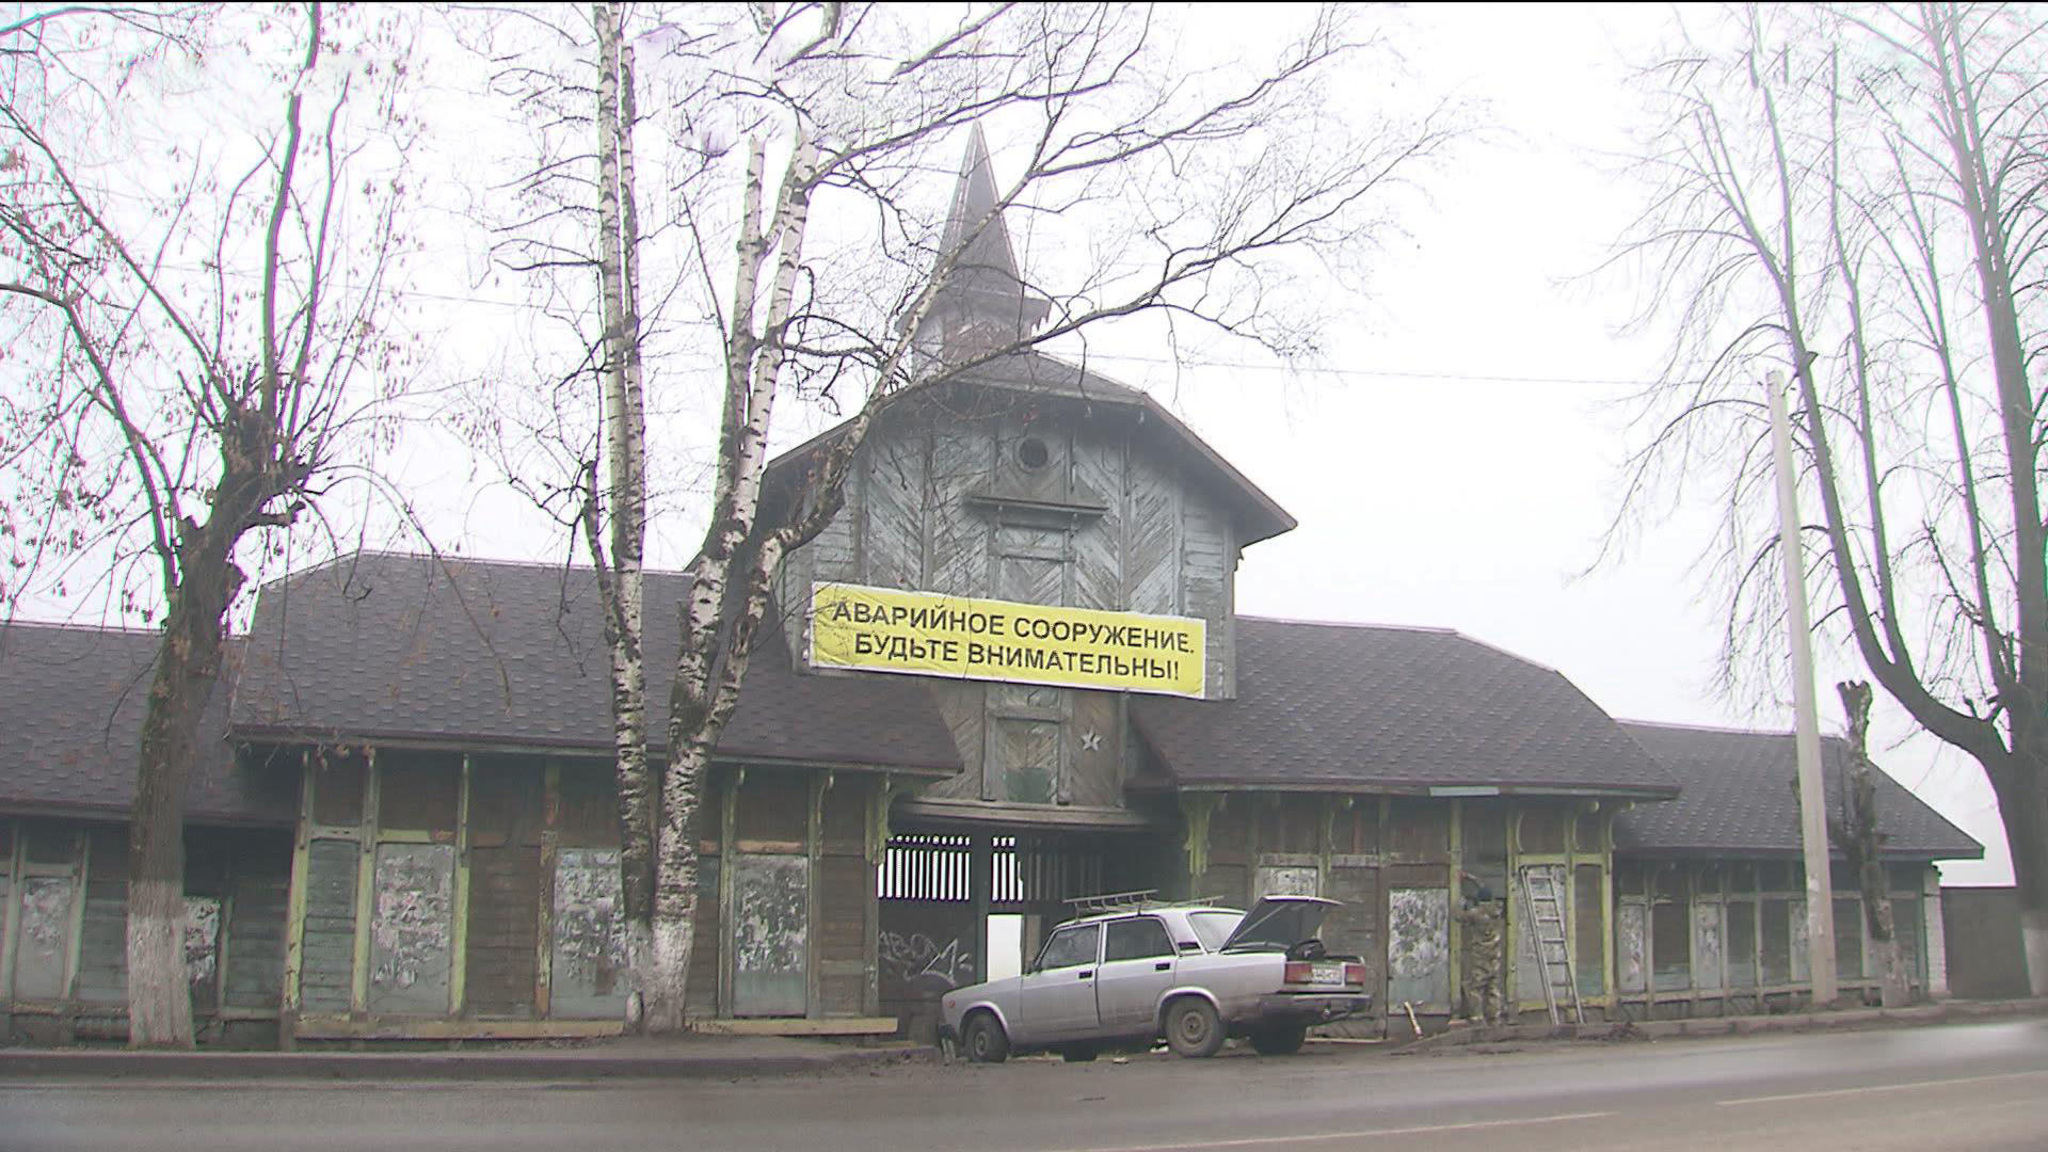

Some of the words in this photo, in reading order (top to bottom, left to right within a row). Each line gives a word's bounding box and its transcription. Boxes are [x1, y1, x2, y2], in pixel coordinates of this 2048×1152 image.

[831, 601, 1004, 636] АВАРИЙНОЕ
[1013, 617, 1195, 654] СООРУЖЕНИЕ.
[854, 632, 958, 662] БУДЬТЕ
[967, 642, 1179, 680] ВНИМАТЕЛЬНЫ!
